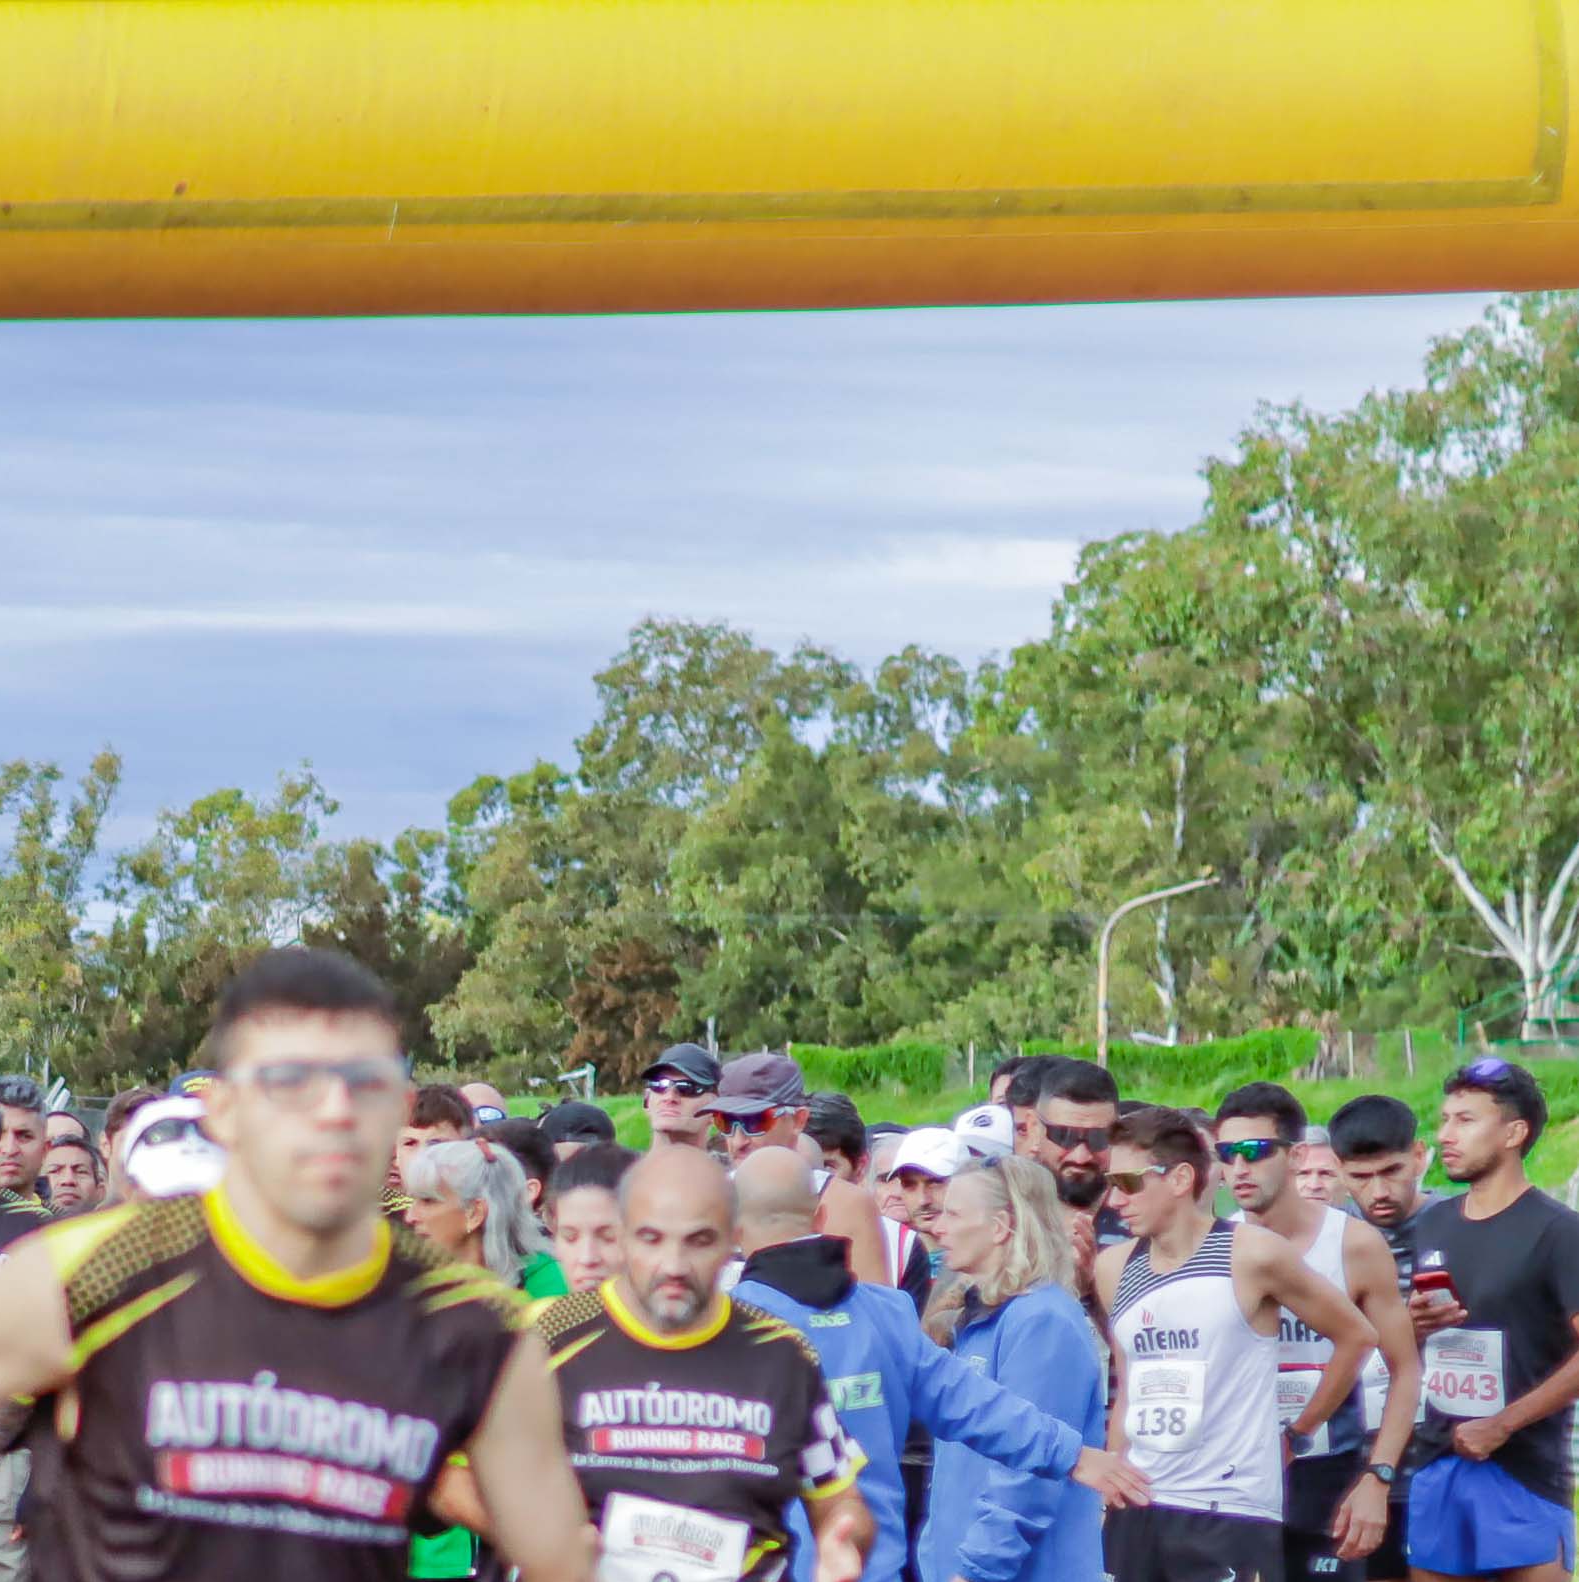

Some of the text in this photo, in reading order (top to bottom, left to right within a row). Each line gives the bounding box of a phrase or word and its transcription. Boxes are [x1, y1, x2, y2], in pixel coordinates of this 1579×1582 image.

[830, 1372, 883, 1412] VEZ
[1427, 1370, 1498, 1401] 4043
[146, 1370, 438, 1482] AUTÓDROMO
[580, 1382, 771, 1436] AUTÓDROMO
[1136, 1407, 1186, 1436] 138
[612, 1430, 745, 1453] RUNNING RACE
